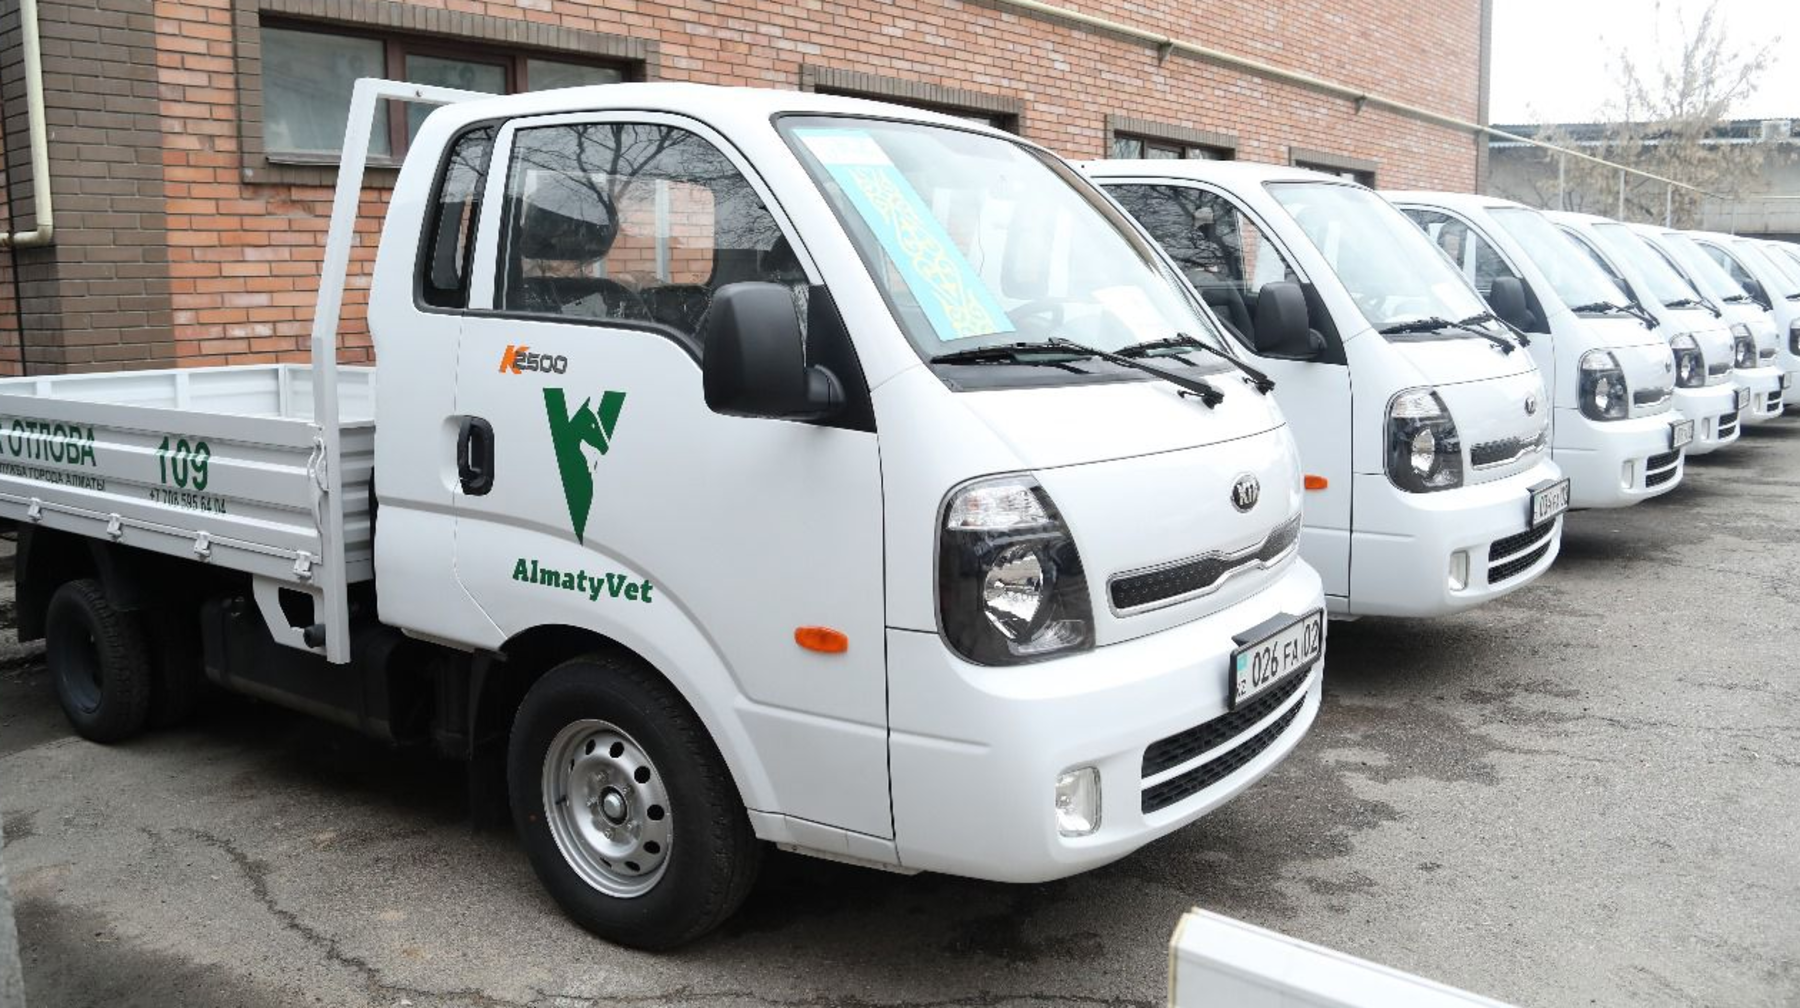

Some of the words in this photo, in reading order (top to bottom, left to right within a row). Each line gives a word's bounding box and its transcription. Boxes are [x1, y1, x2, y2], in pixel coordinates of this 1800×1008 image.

[500, 345, 568, 374] K2500
[8, 419, 97, 467] ОТЛОВА
[158, 436, 210, 491] 109
[28, 467, 63, 484] ГОРОДА
[66, 472, 106, 491] АЛМАТЫ
[513, 558, 653, 603] AlmatyVet
[1252, 641, 1279, 688] 026
[1284, 638, 1299, 670] FA
[1304, 620, 1320, 658] 02
